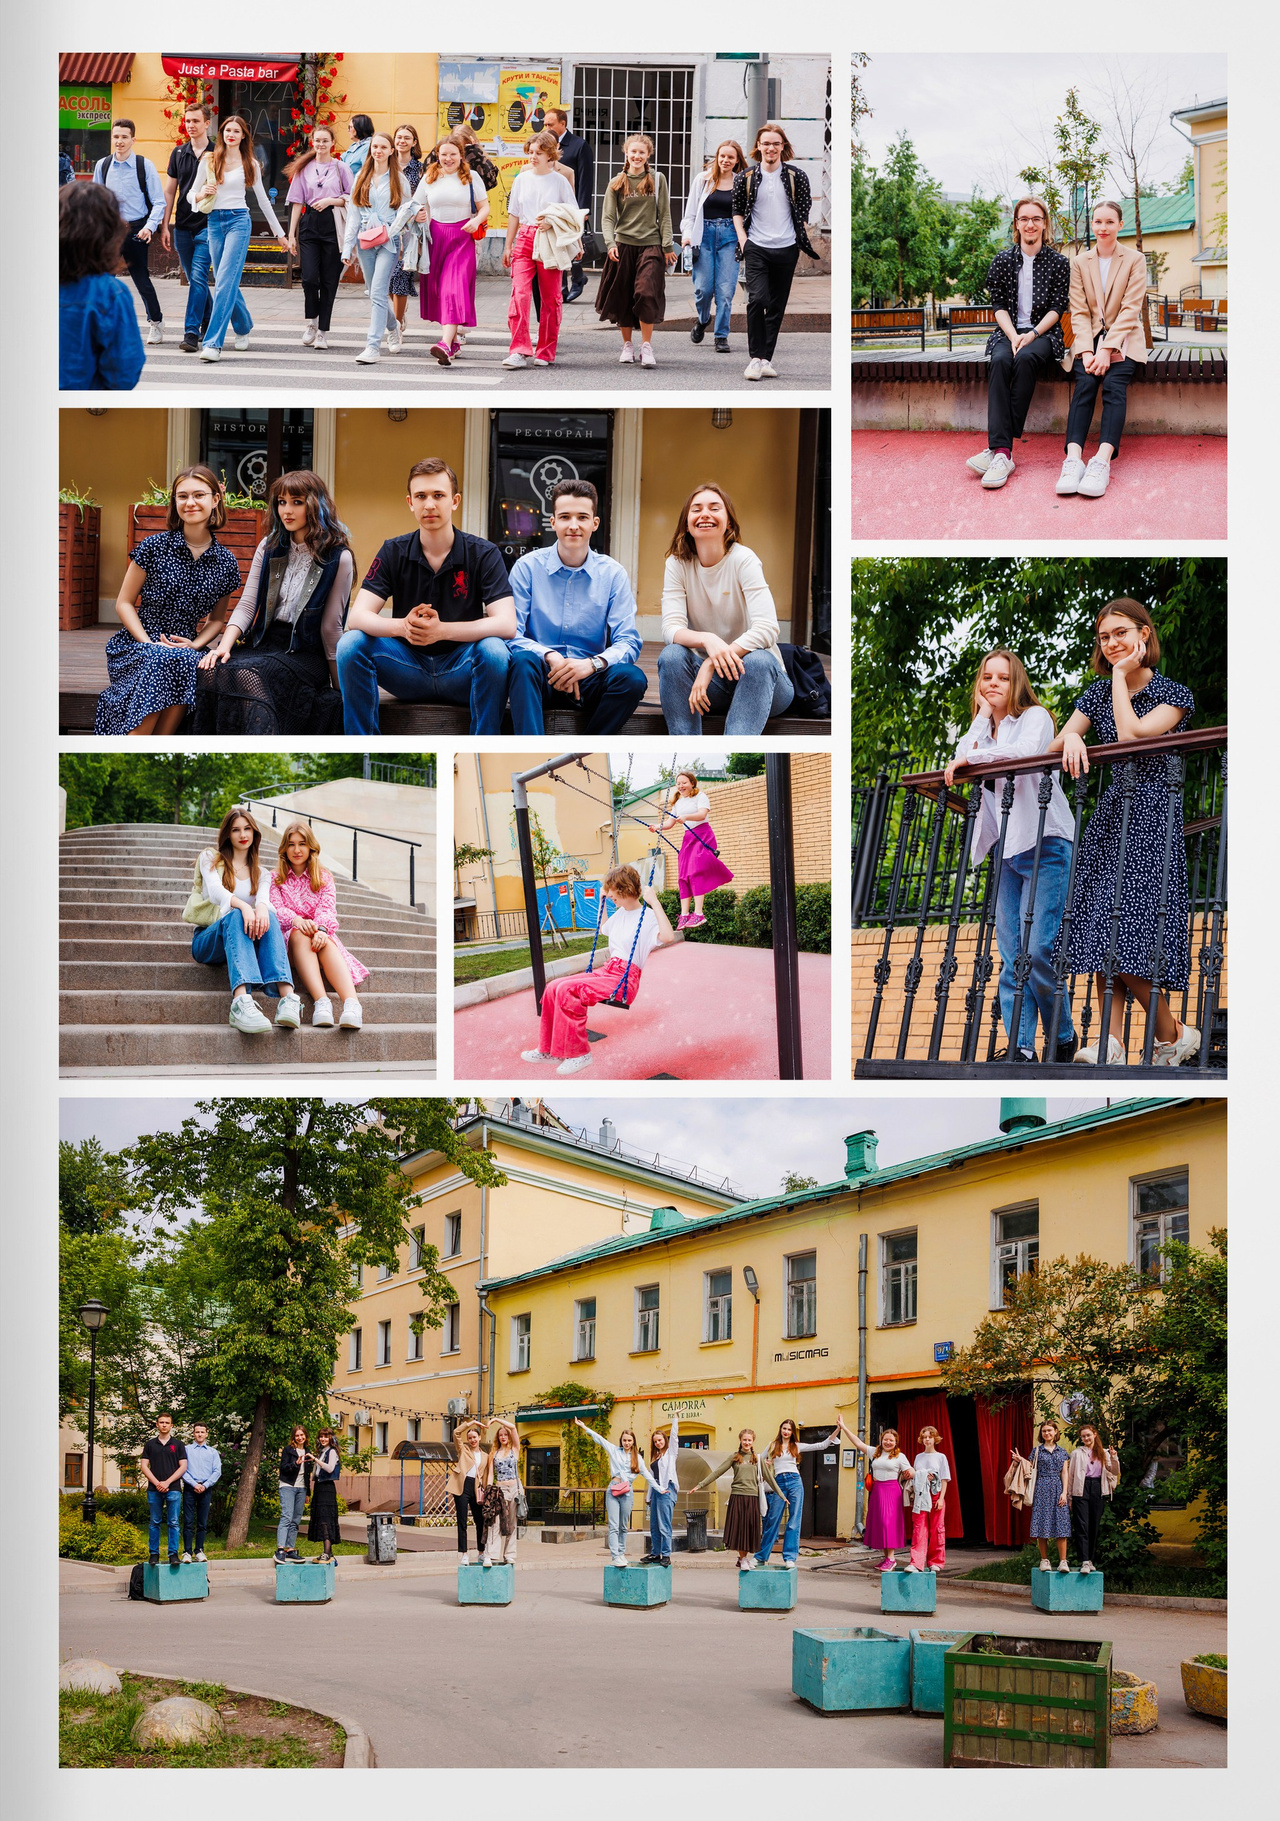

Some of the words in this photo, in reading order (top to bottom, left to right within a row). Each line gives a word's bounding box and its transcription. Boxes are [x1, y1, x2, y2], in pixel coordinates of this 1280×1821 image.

[220, 64, 254, 78] Pasta
[258, 66, 279, 79] bar
[235, 81, 295, 102] PIZZA
[77, 111, 111, 122] экспресс
[213, 423, 305, 434] RISTORTE
[515, 428, 593, 439] РЕСТОРАН
